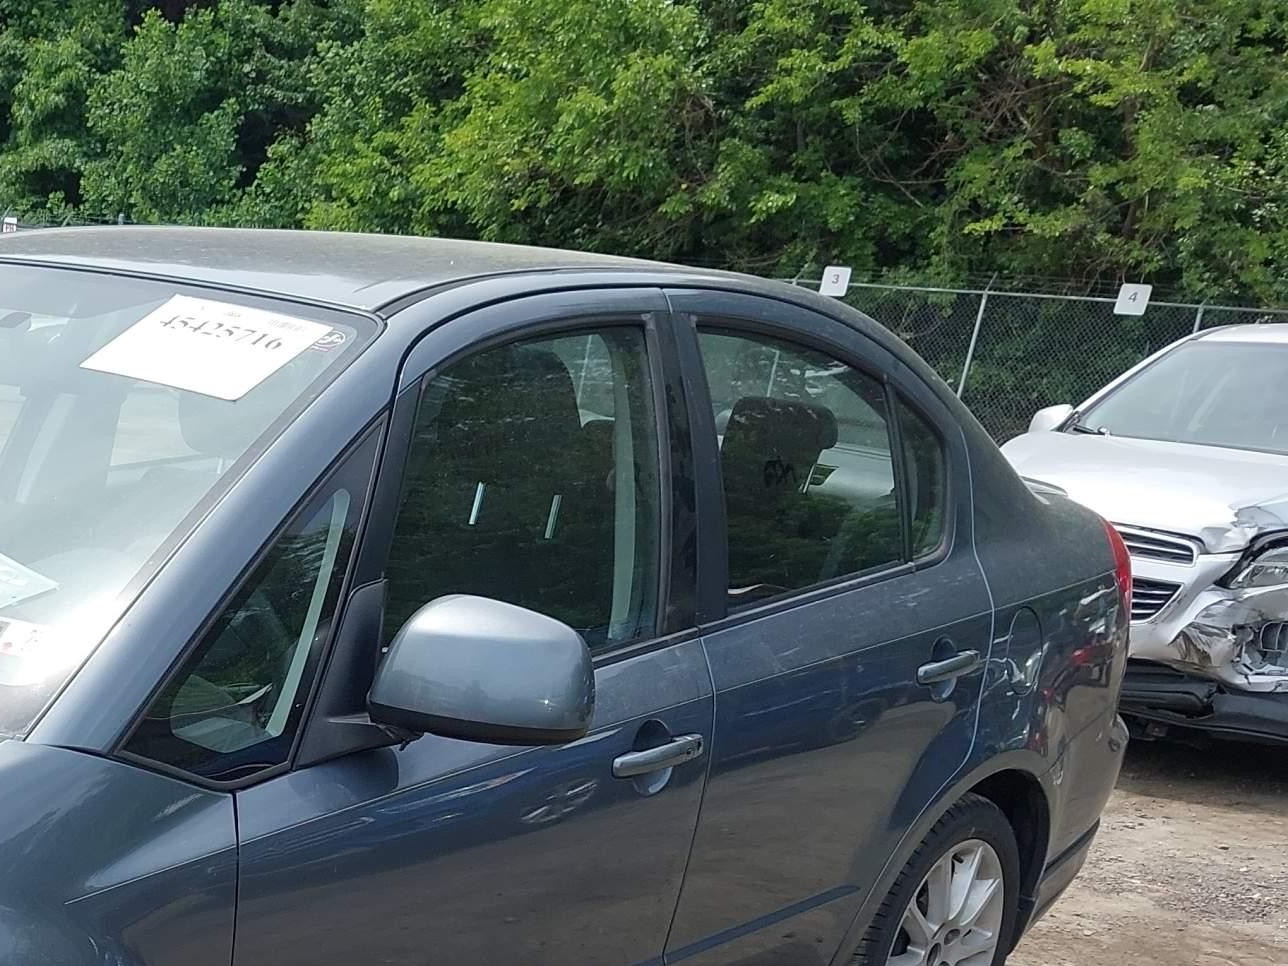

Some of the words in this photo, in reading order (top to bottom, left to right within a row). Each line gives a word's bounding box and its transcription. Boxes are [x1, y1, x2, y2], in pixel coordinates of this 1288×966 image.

[831, 274, 840, 285] 3
[1128, 291, 1138, 303] 4
[158, 314, 282, 351] 45425716
